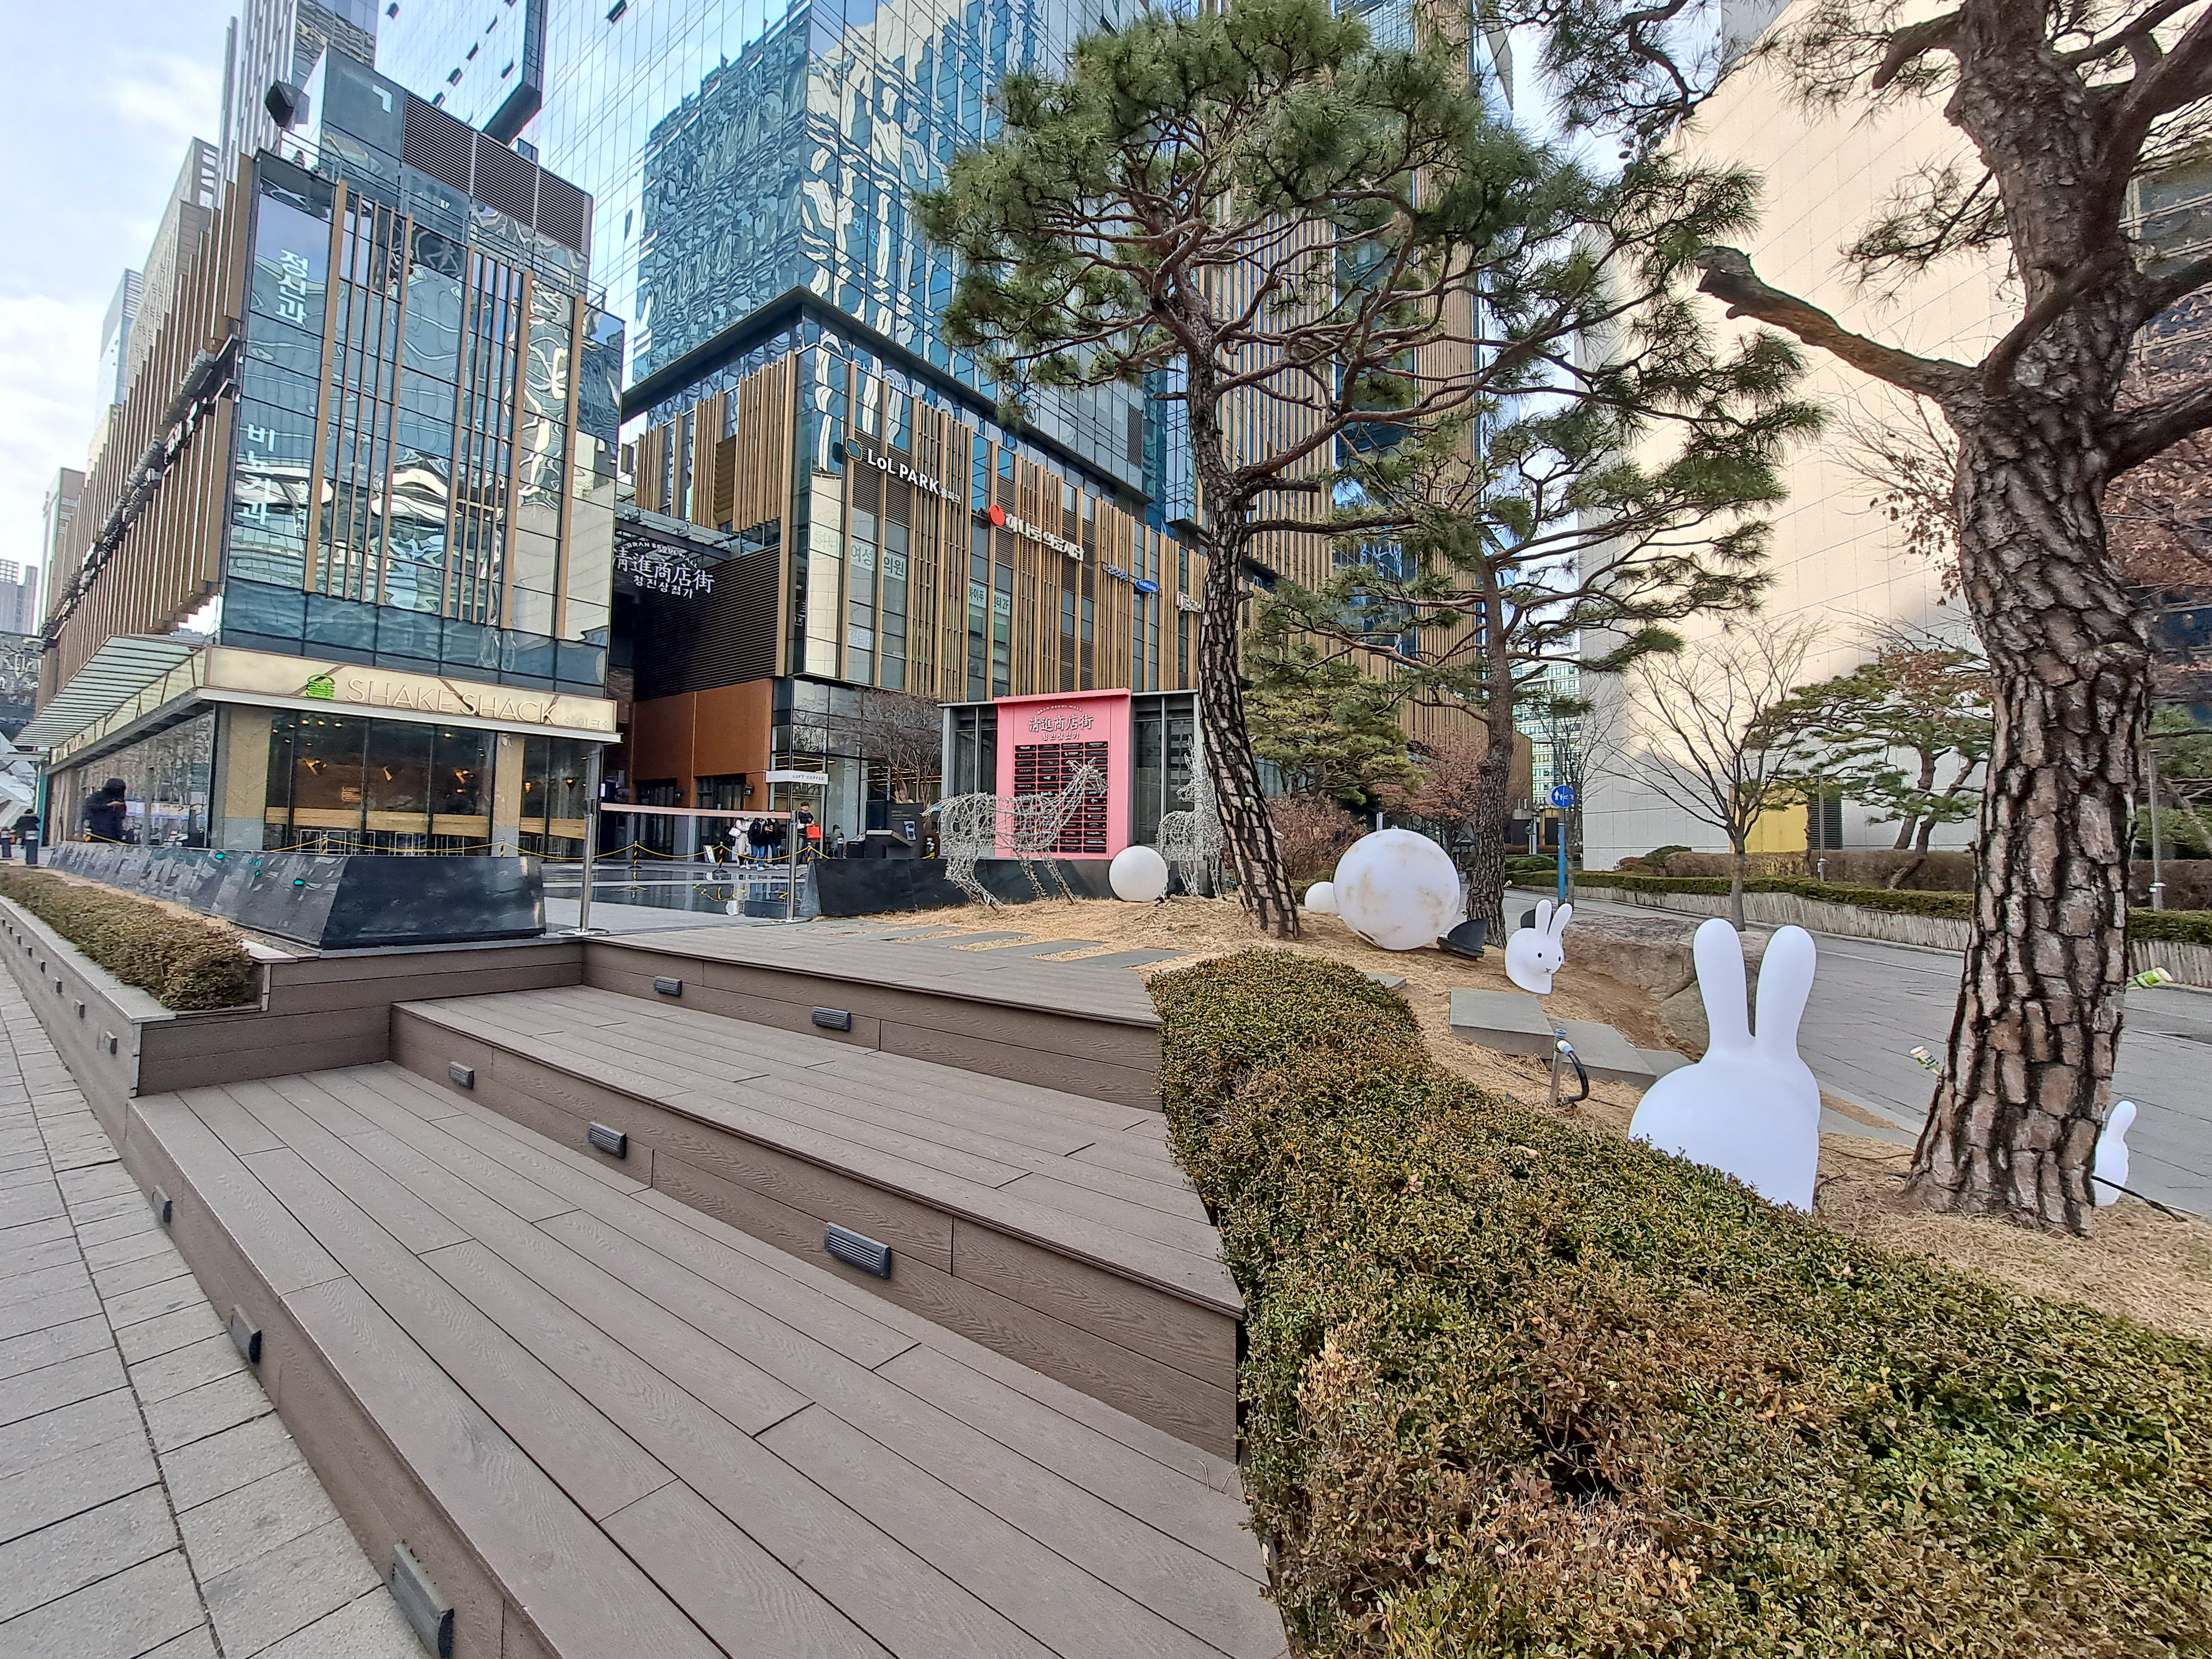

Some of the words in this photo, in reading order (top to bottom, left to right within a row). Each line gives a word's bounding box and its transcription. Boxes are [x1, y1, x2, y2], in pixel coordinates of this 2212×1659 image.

[275, 249, 308, 324] 정신과
[237, 423, 275, 525] 비뇨기과
[867, 448, 896, 474] LoL
[899, 463, 940, 495] PARK
[1005, 513, 1042, 543] 하나로
[651, 542, 677, 555] SEOUL
[679, 553, 698, 568] MALL
[633, 575, 693, 599] 청진상점가
[346, 678, 453, 713] SHAKE
[459, 692, 556, 725] SHACK
